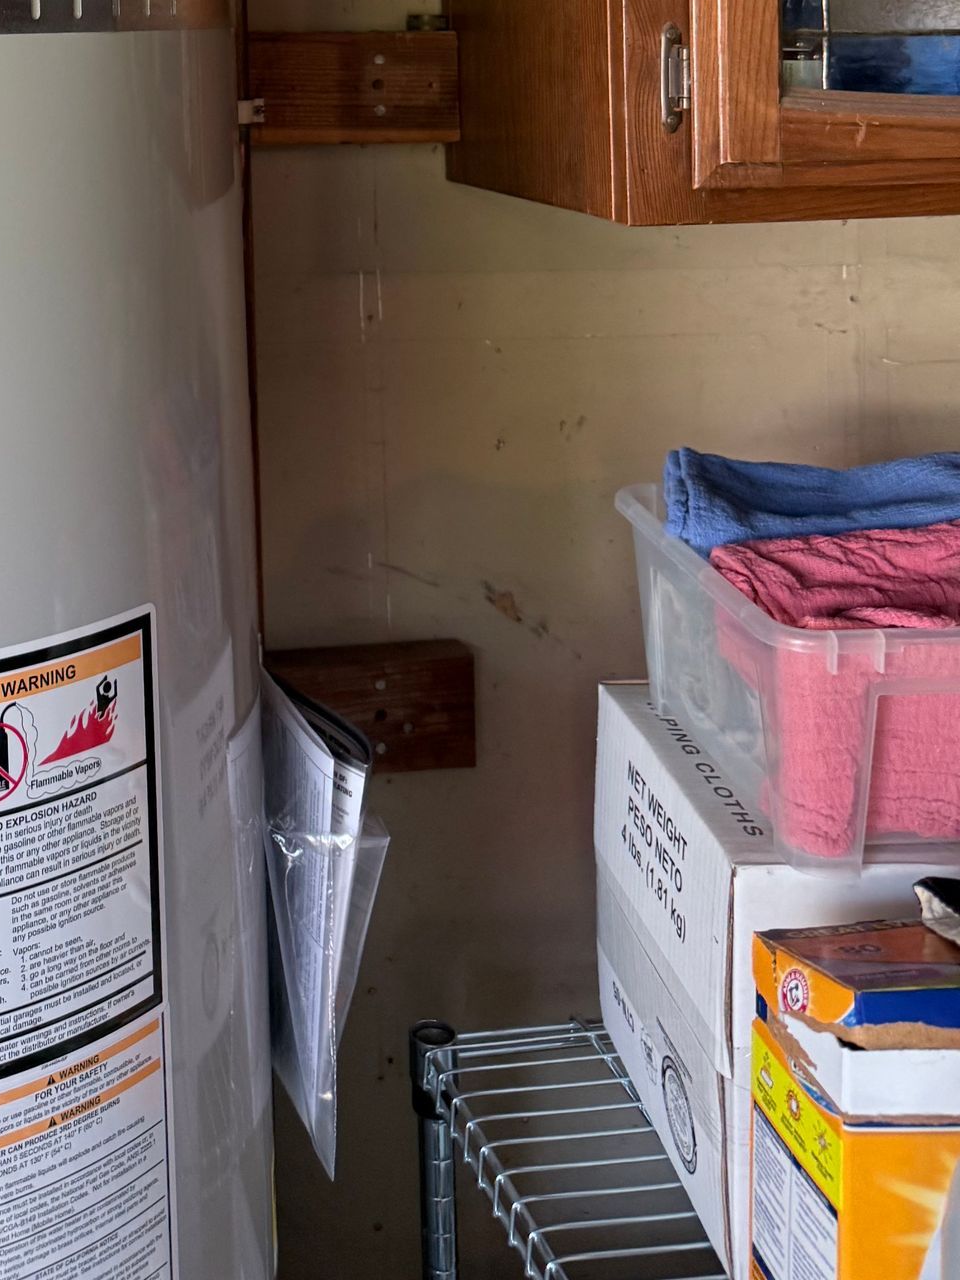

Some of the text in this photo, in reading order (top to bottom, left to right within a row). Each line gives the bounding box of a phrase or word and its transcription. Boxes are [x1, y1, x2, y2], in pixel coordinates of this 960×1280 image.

[0, 664, 76, 698] WARNING
[30, 759, 101, 790] Flammable Vapors
[5, 806, 59, 831] EXPLOSION
[61, 791, 98, 812] HAZARD
[627, 759, 688, 861] NET WEIGHT
[695, 761, 764, 837] CLOTHS
[6, 830, 14, 842] in
[14, 823, 42, 839] serious
[44, 815, 63, 834] injury
[64, 814, 72, 824] or
[74, 805, 94, 821] death
[628, 796, 684, 894] PESO NETO
[620, 824, 687, 944] 4 lbs. (1.81 kg)
[34, 1089, 53, 1102] FOR
[54, 1076, 78, 1097] YOUR
[78, 1062, 108, 1087] SAFETY
[58, 1054, 100, 1080] WARNING
[60, 1095, 102, 1122] WARNING
